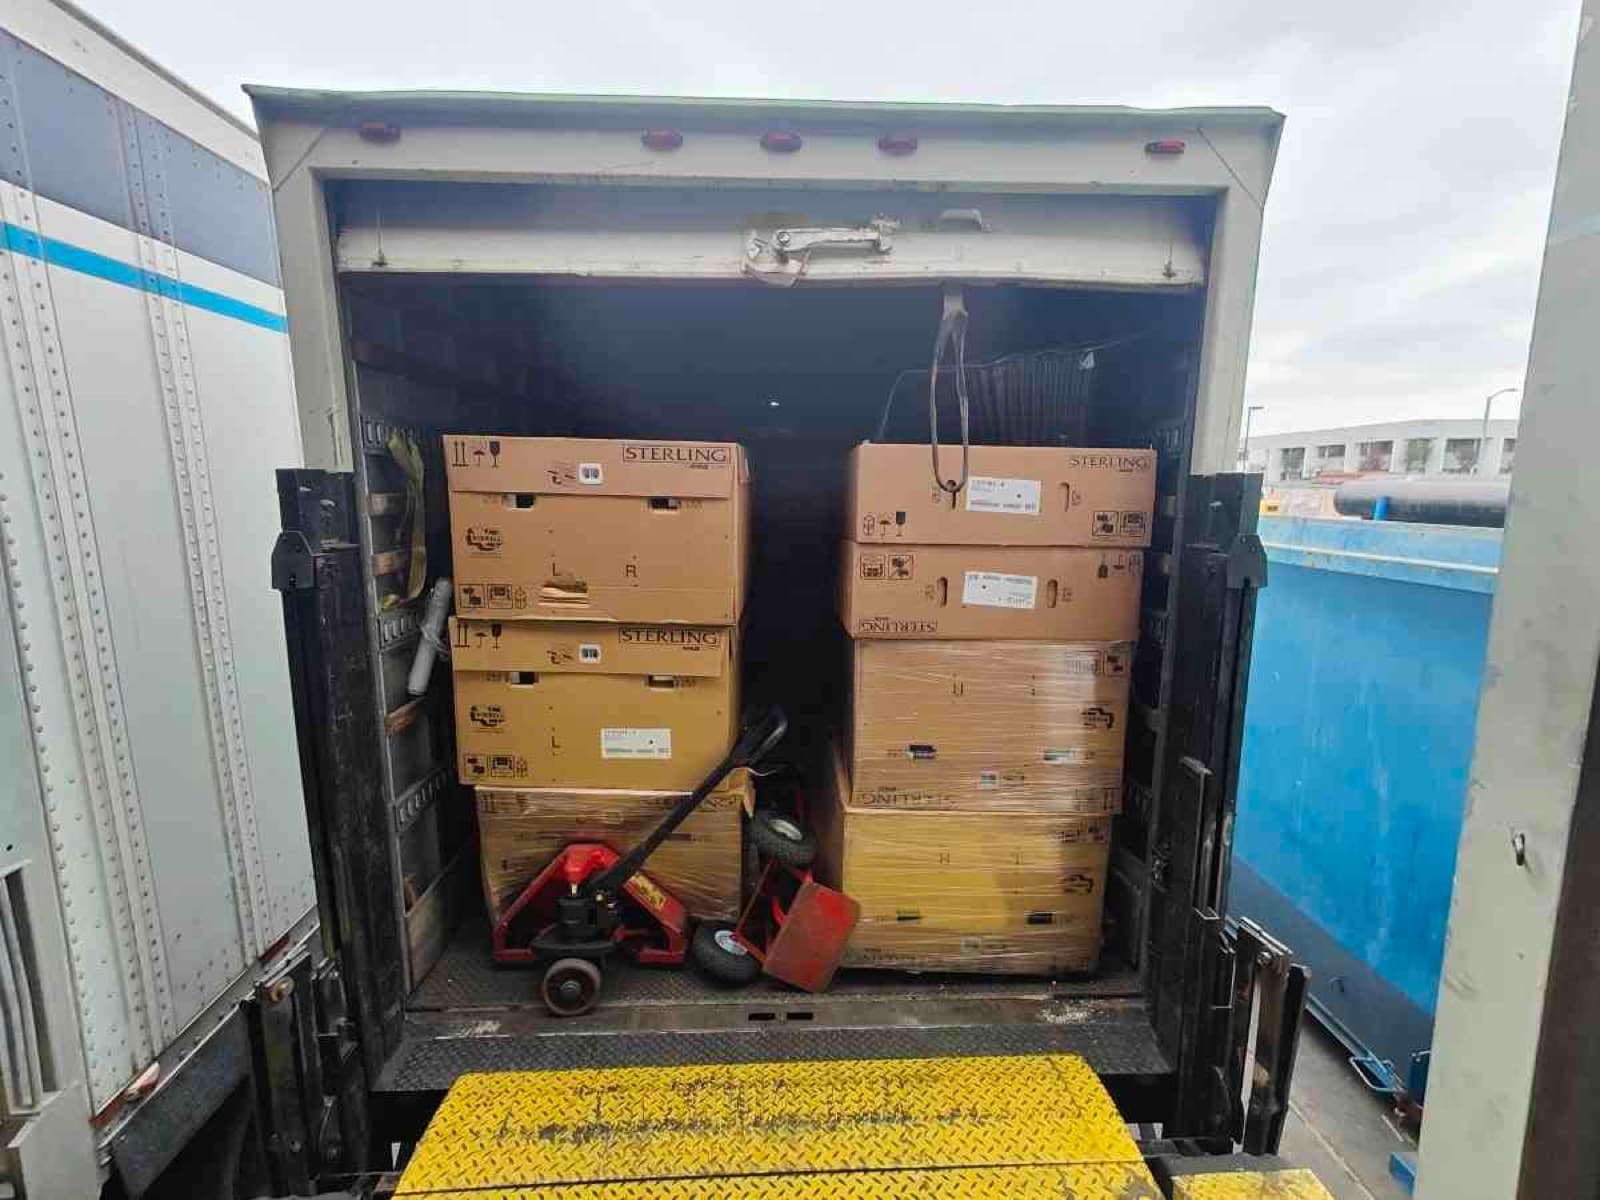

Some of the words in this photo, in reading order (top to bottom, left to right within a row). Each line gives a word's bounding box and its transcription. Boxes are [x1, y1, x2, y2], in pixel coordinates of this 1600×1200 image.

[625, 447, 727, 461] STERLING
[1070, 455, 1150, 469] STERLING
[625, 564, 638, 578] R
[862, 621, 936, 633] STERLING
[621, 630, 718, 644] STERLING
